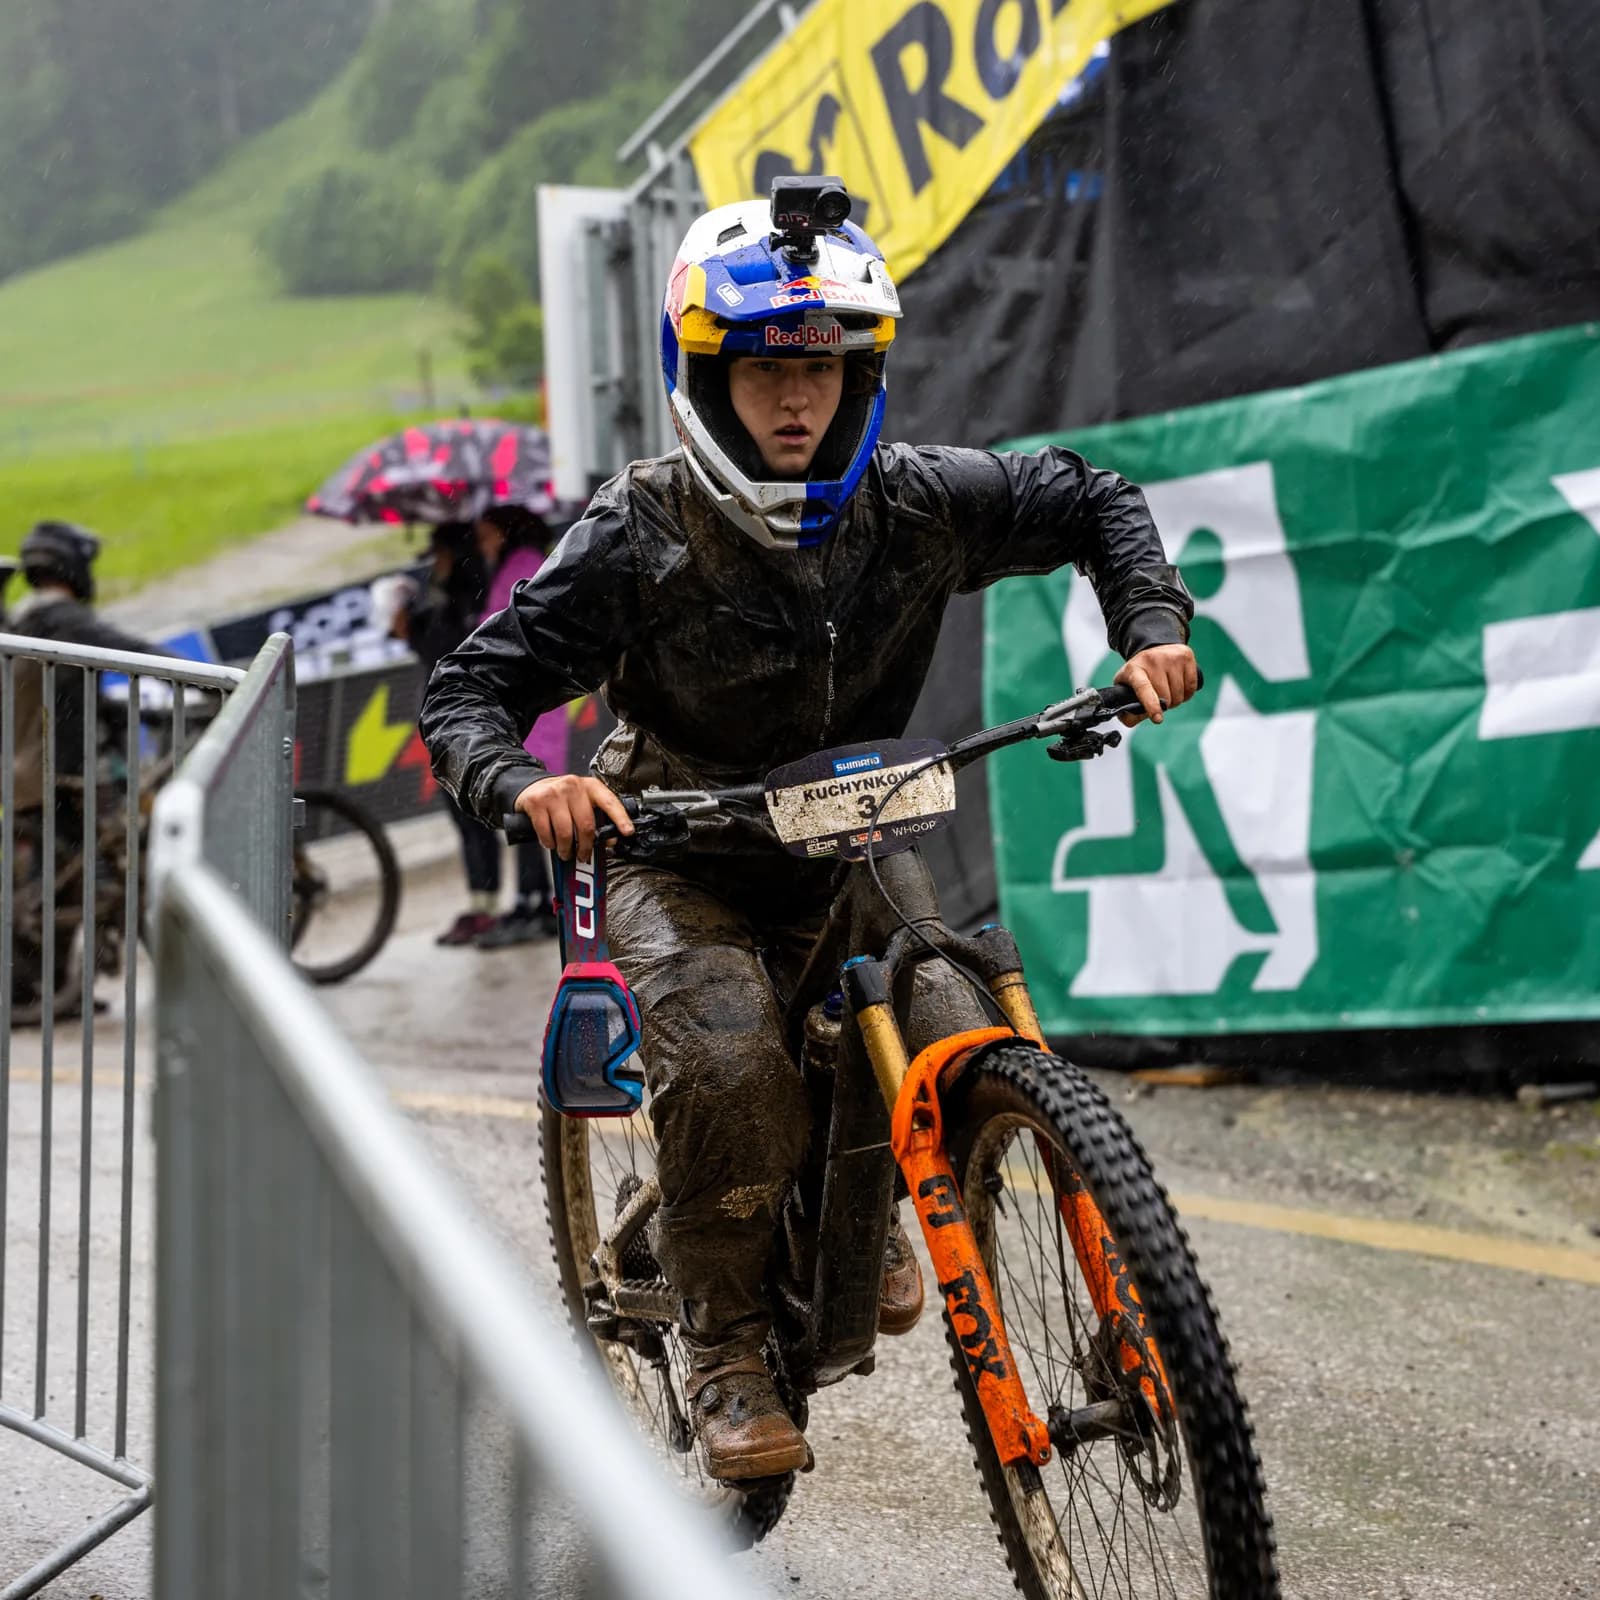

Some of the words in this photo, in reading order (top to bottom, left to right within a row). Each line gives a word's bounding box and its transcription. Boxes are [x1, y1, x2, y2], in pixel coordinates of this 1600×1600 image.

[835, 756, 880, 772] SHIMANO
[857, 794, 878, 819] 3
[891, 820, 936, 837] WHOOP
[806, 839, 838, 852] EDR
[939, 1270, 1006, 1389] FOX
